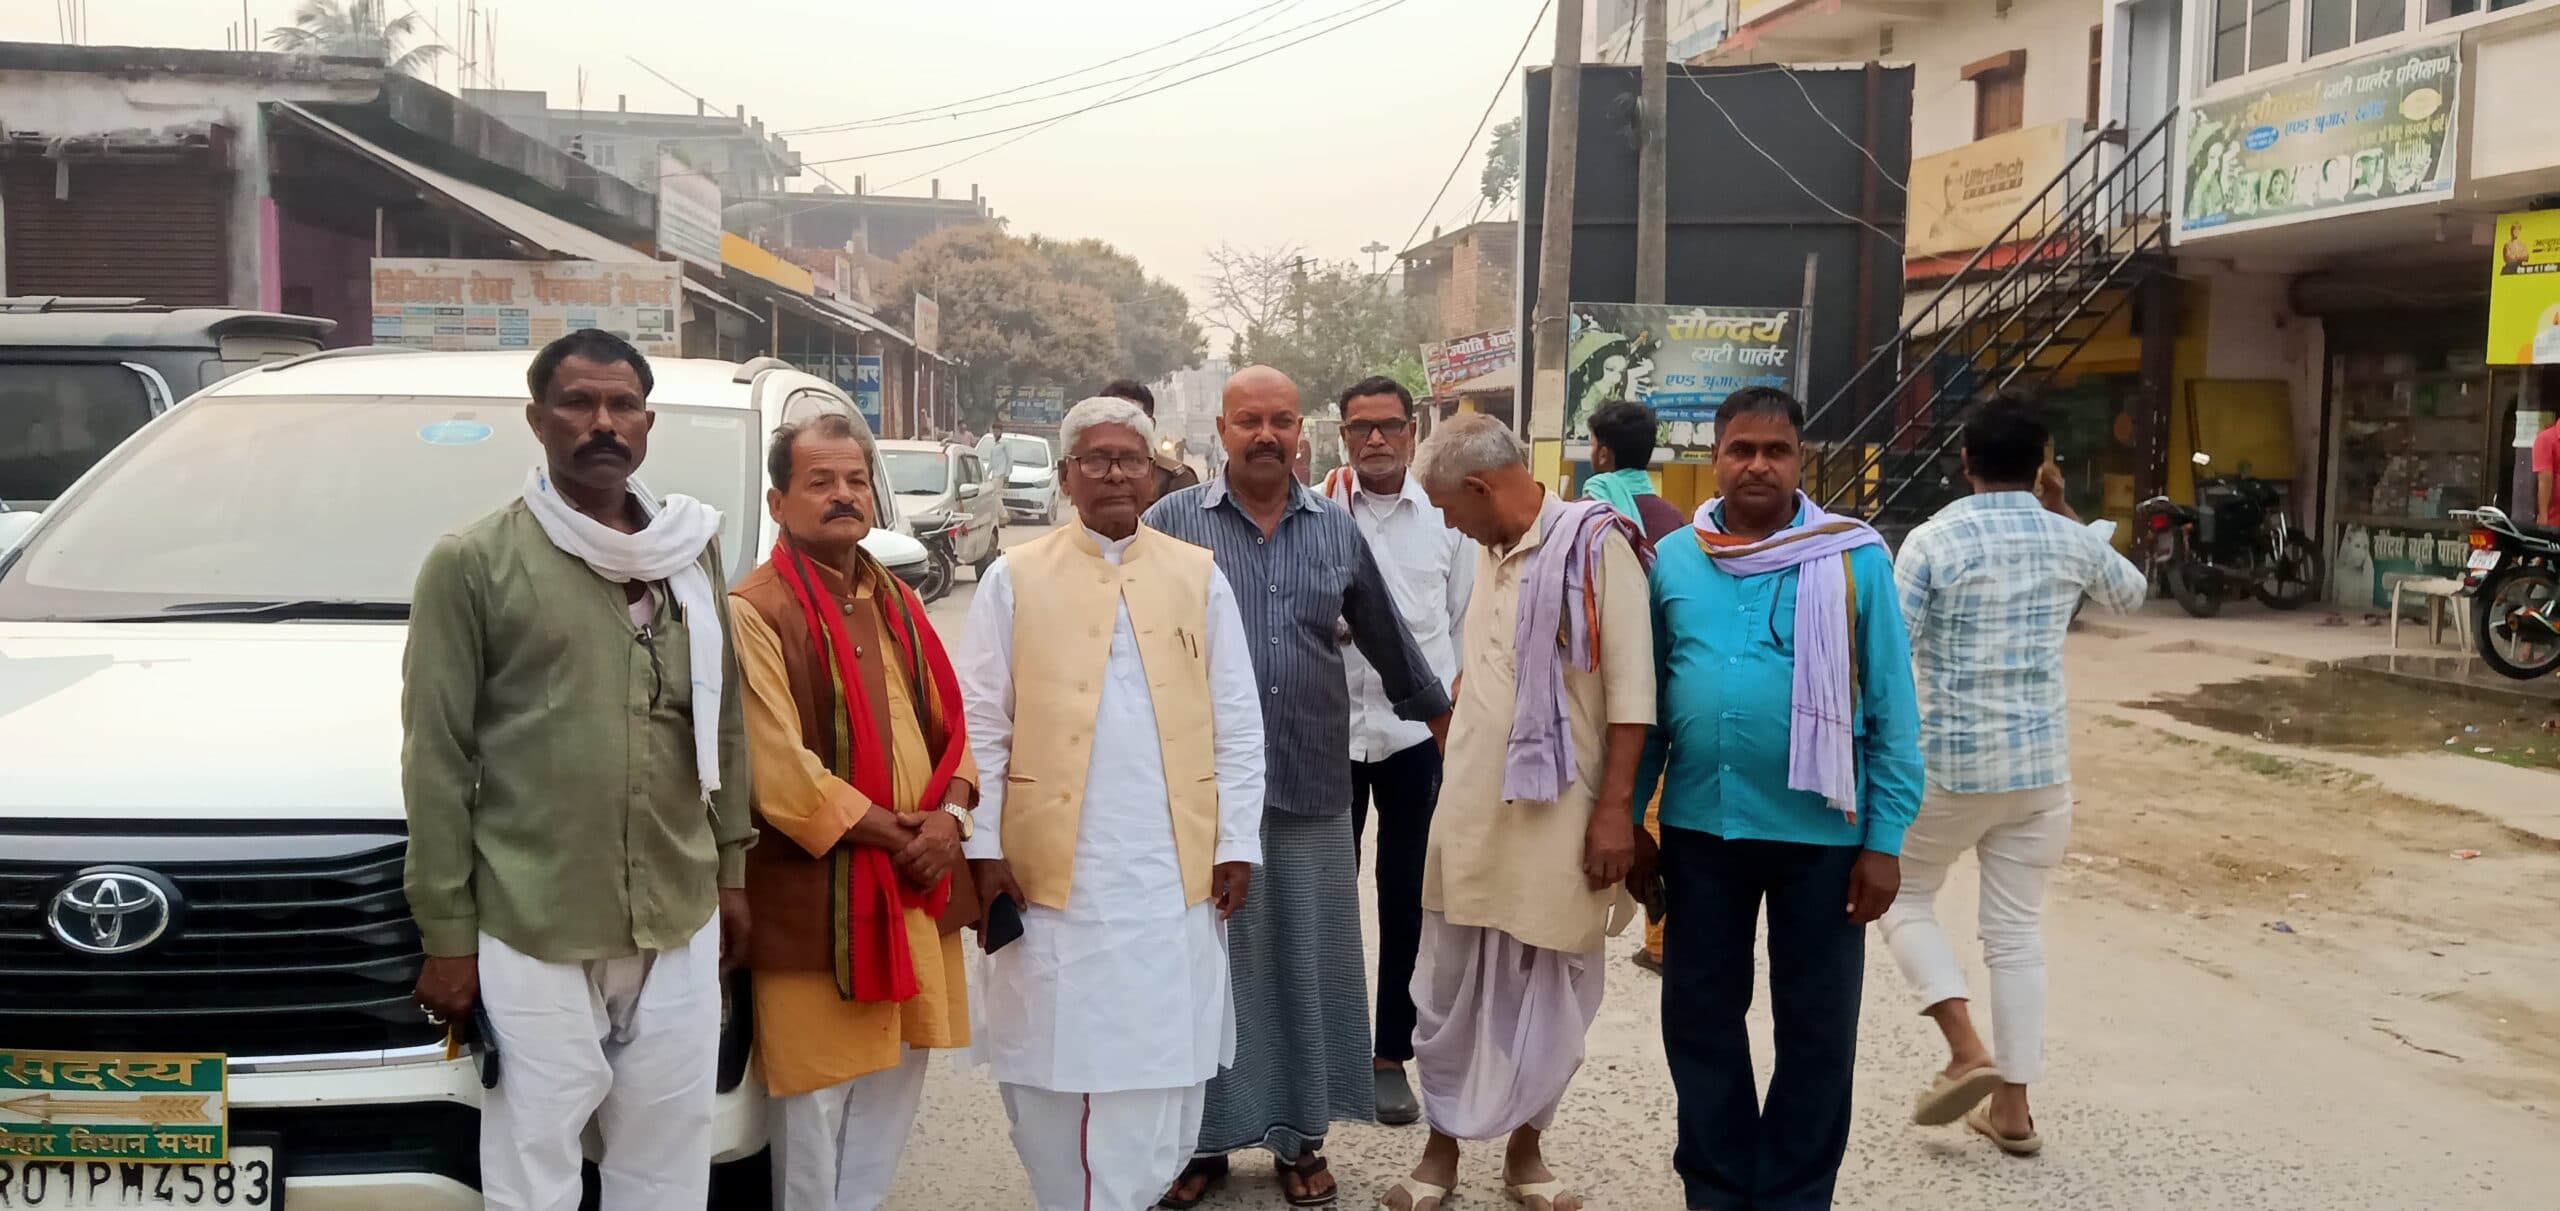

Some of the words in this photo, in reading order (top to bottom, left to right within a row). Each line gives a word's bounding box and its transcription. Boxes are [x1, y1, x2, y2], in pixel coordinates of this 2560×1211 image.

[1964, 157, 2023, 188] UltraTech
[1666, 307, 1790, 343] सौन्दर्य
[1738, 345, 1788, 367] पार्लर
[3, 1053, 202, 1090] सदस्य
[67, 1127, 149, 1154] विधान
[153, 1132, 216, 1153] सभा
